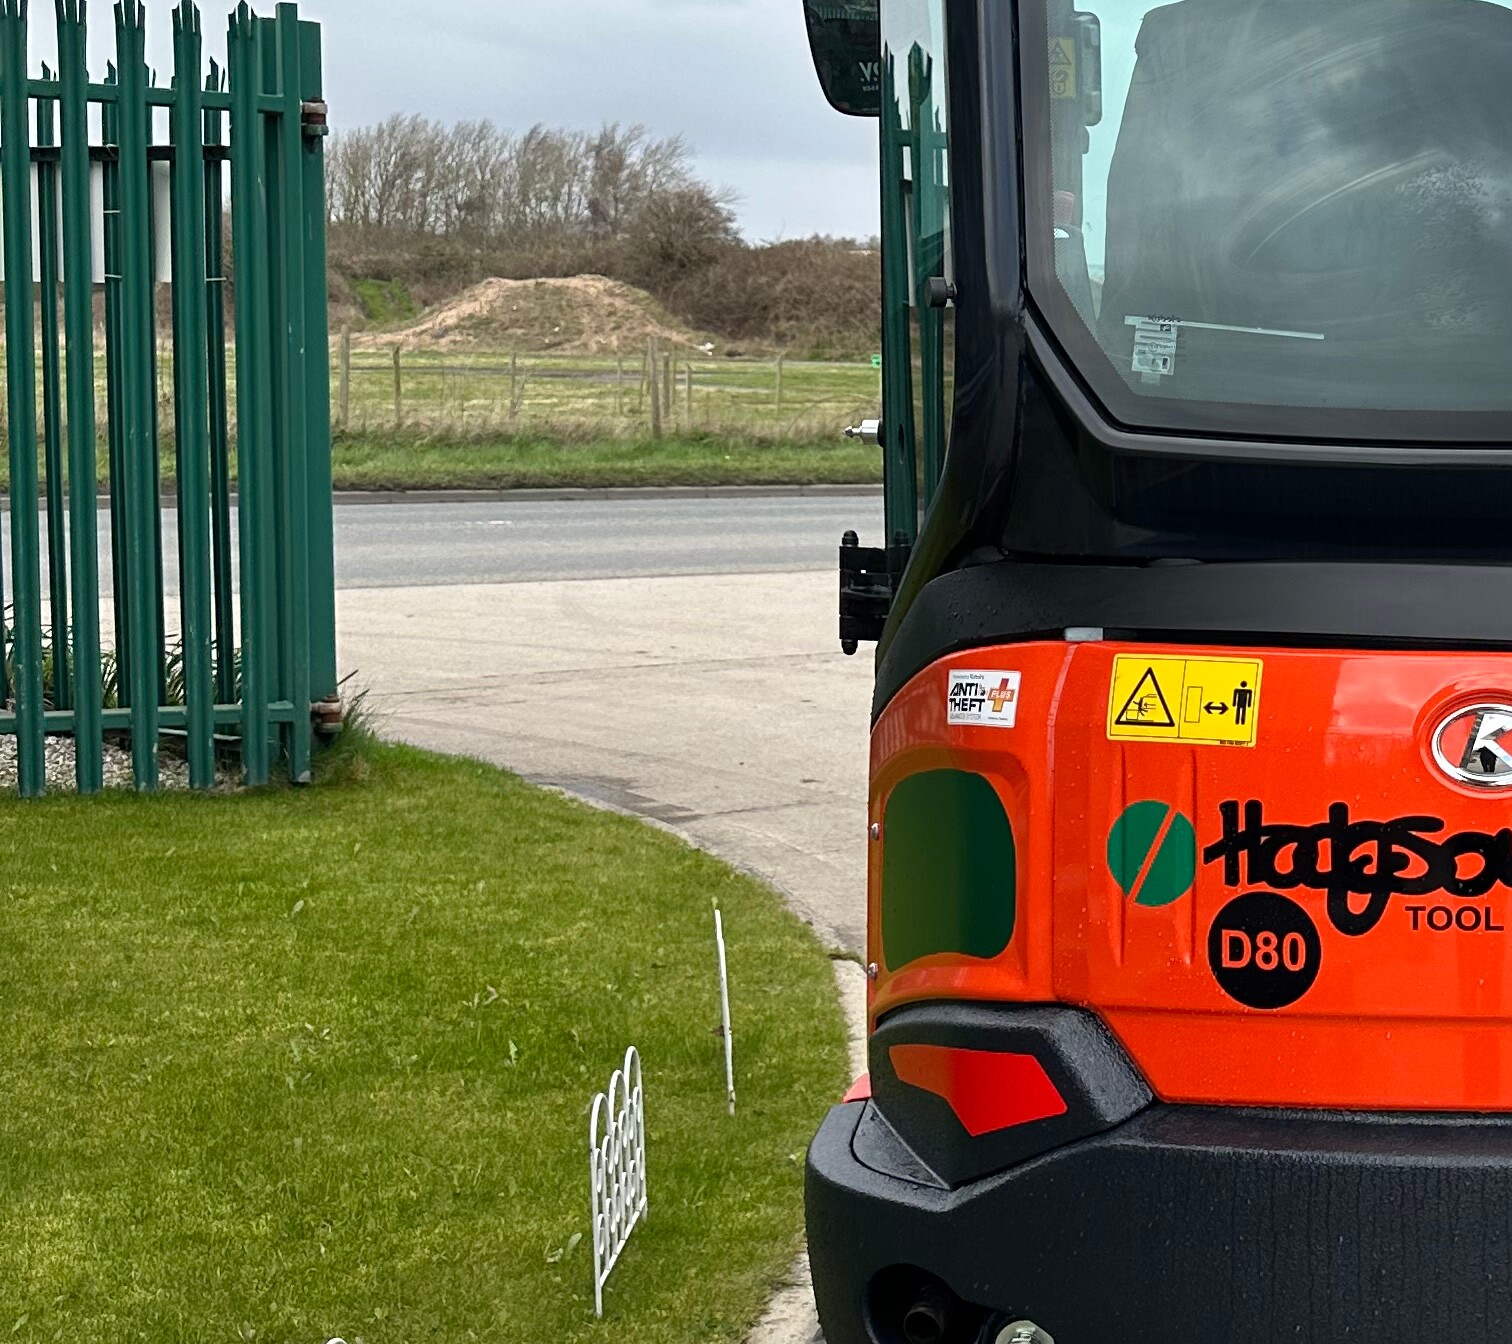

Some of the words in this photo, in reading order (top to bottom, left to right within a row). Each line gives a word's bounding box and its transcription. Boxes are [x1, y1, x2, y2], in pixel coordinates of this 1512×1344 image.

[950, 682, 979, 696] ANTI
[949, 698, 985, 712] THEFT
[1405, 906, 1504, 931] TOOL
[1222, 929, 1306, 971] D80
